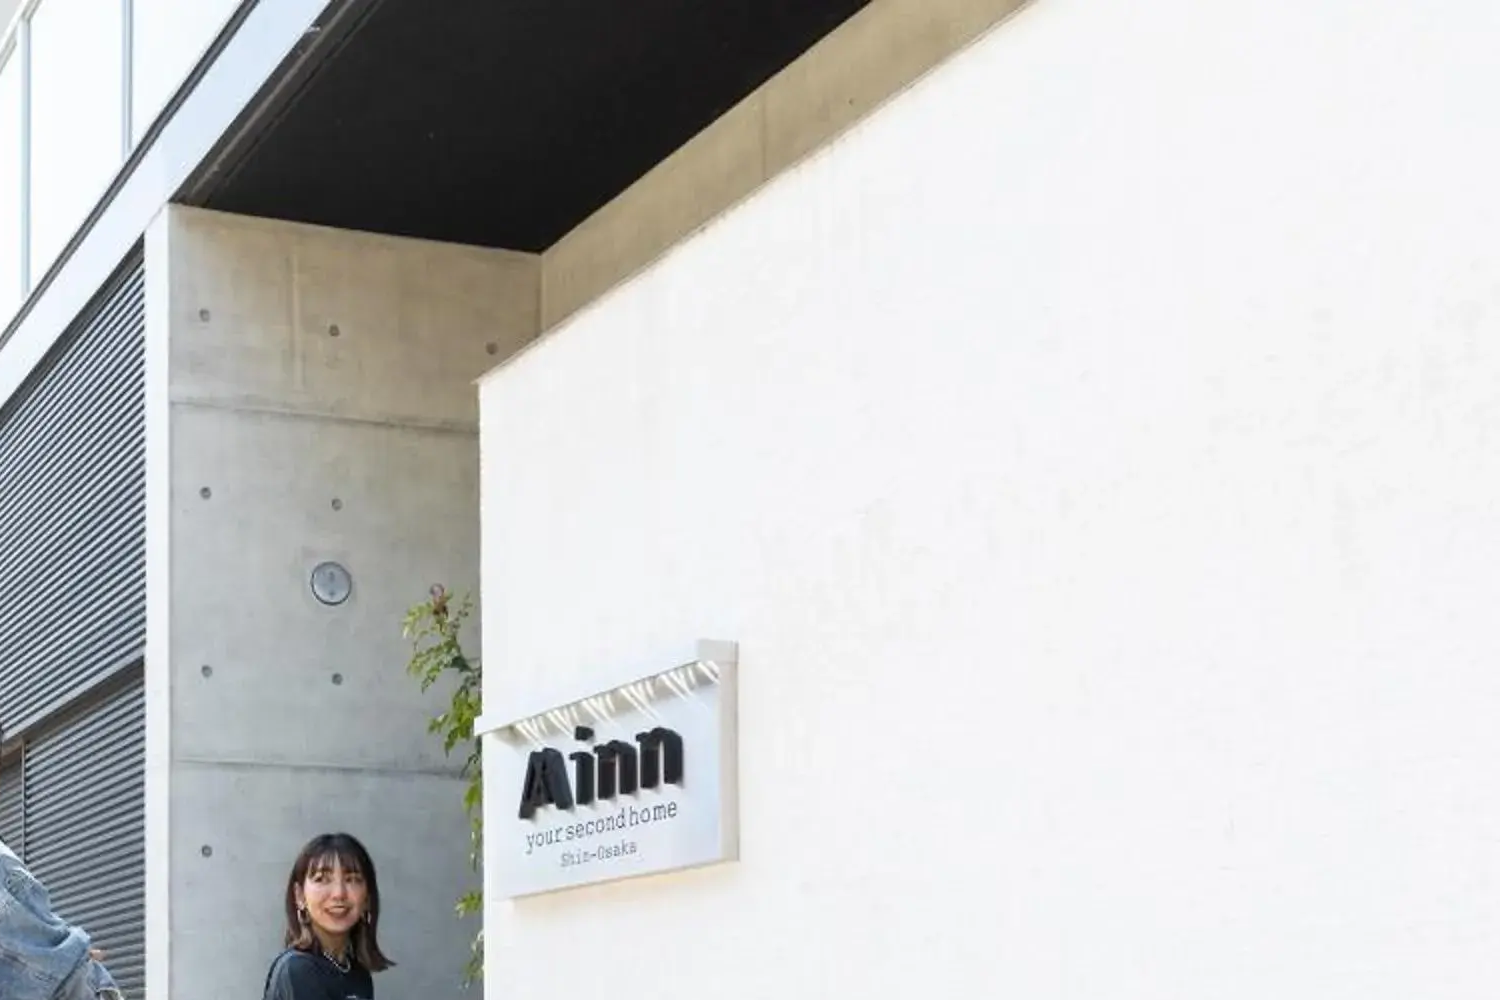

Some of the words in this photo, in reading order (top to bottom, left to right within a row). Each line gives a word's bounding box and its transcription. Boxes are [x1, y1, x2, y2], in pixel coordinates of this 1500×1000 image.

[518, 725, 684, 820] Ainn
[525, 824, 564, 855] your
[564, 807, 627, 842] second
[629, 800, 678, 826] home
[560, 838, 638, 868] Shin-Osaka
